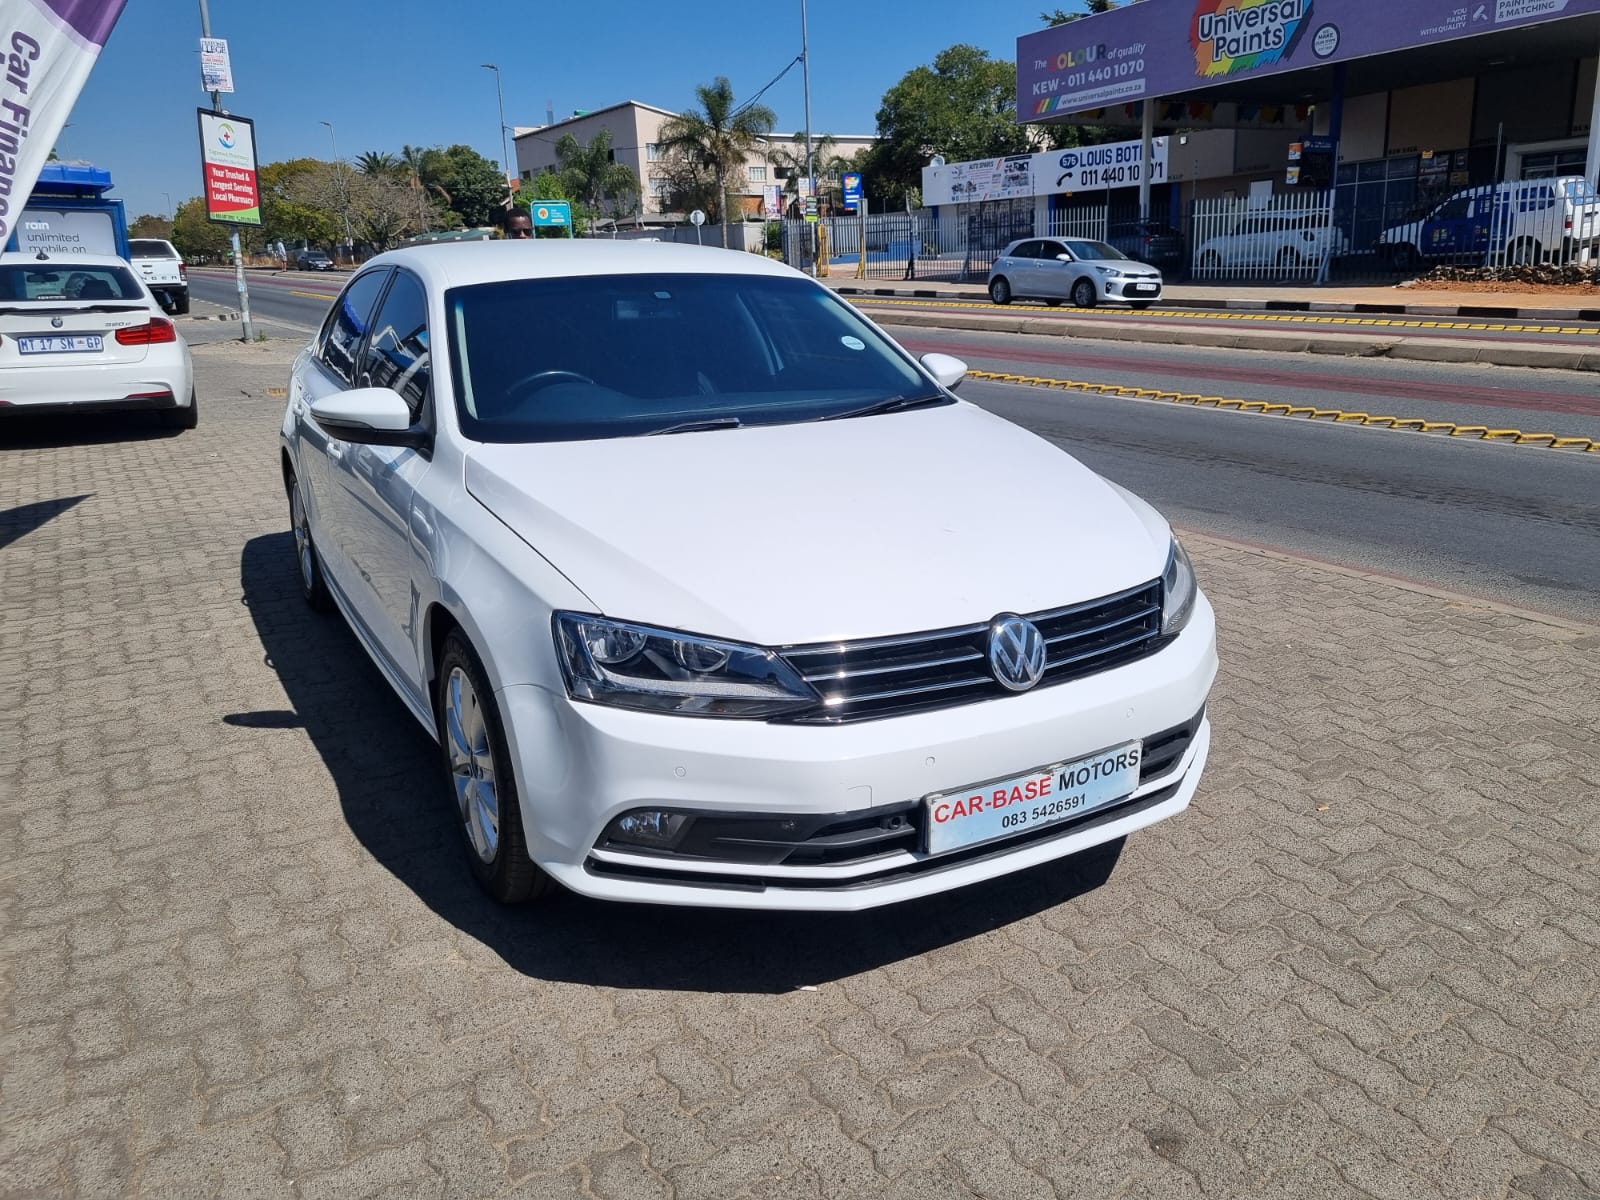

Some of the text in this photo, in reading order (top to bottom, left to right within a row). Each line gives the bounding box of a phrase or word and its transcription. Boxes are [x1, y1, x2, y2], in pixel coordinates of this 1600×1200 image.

[1506, 1, 1555, 17] MATCHING
[1200, 0, 1302, 39] Universal
[1446, 15, 1467, 24] PAINT
[1420, 22, 1467, 36] WITH QUALITY
[1214, 26, 1284, 58] Paints
[6, 31, 41, 95] Car
[1033, 42, 1146, 72] The COLOUR of quality
[1032, 78, 1060, 96] KEW
[1068, 72, 1086, 87] 011
[1088, 66, 1112, 83] 440
[1113, 59, 1145, 77] 1070
[1061, 83, 1142, 105] www.universalpaints.co.za
[1062, 156, 1076, 167] 575
[1080, 148, 1113, 168] LOUIS
[211, 167, 250, 181] Your Trusted &
[1081, 169, 1098, 186] 011
[1101, 167, 1125, 184] 440
[210, 179, 254, 195] Longest Serving
[212, 191, 254, 207] Local Pharmacy
[25, 220, 50, 230] rain
[27, 231, 80, 243] unlimited
[29, 242, 87, 253] mobile on
[20, 337, 101, 350] MT 17 SN GP
[934, 750, 1139, 824] CAR-BASE MOTORS
[1002, 793, 1086, 829] 083 5426591
